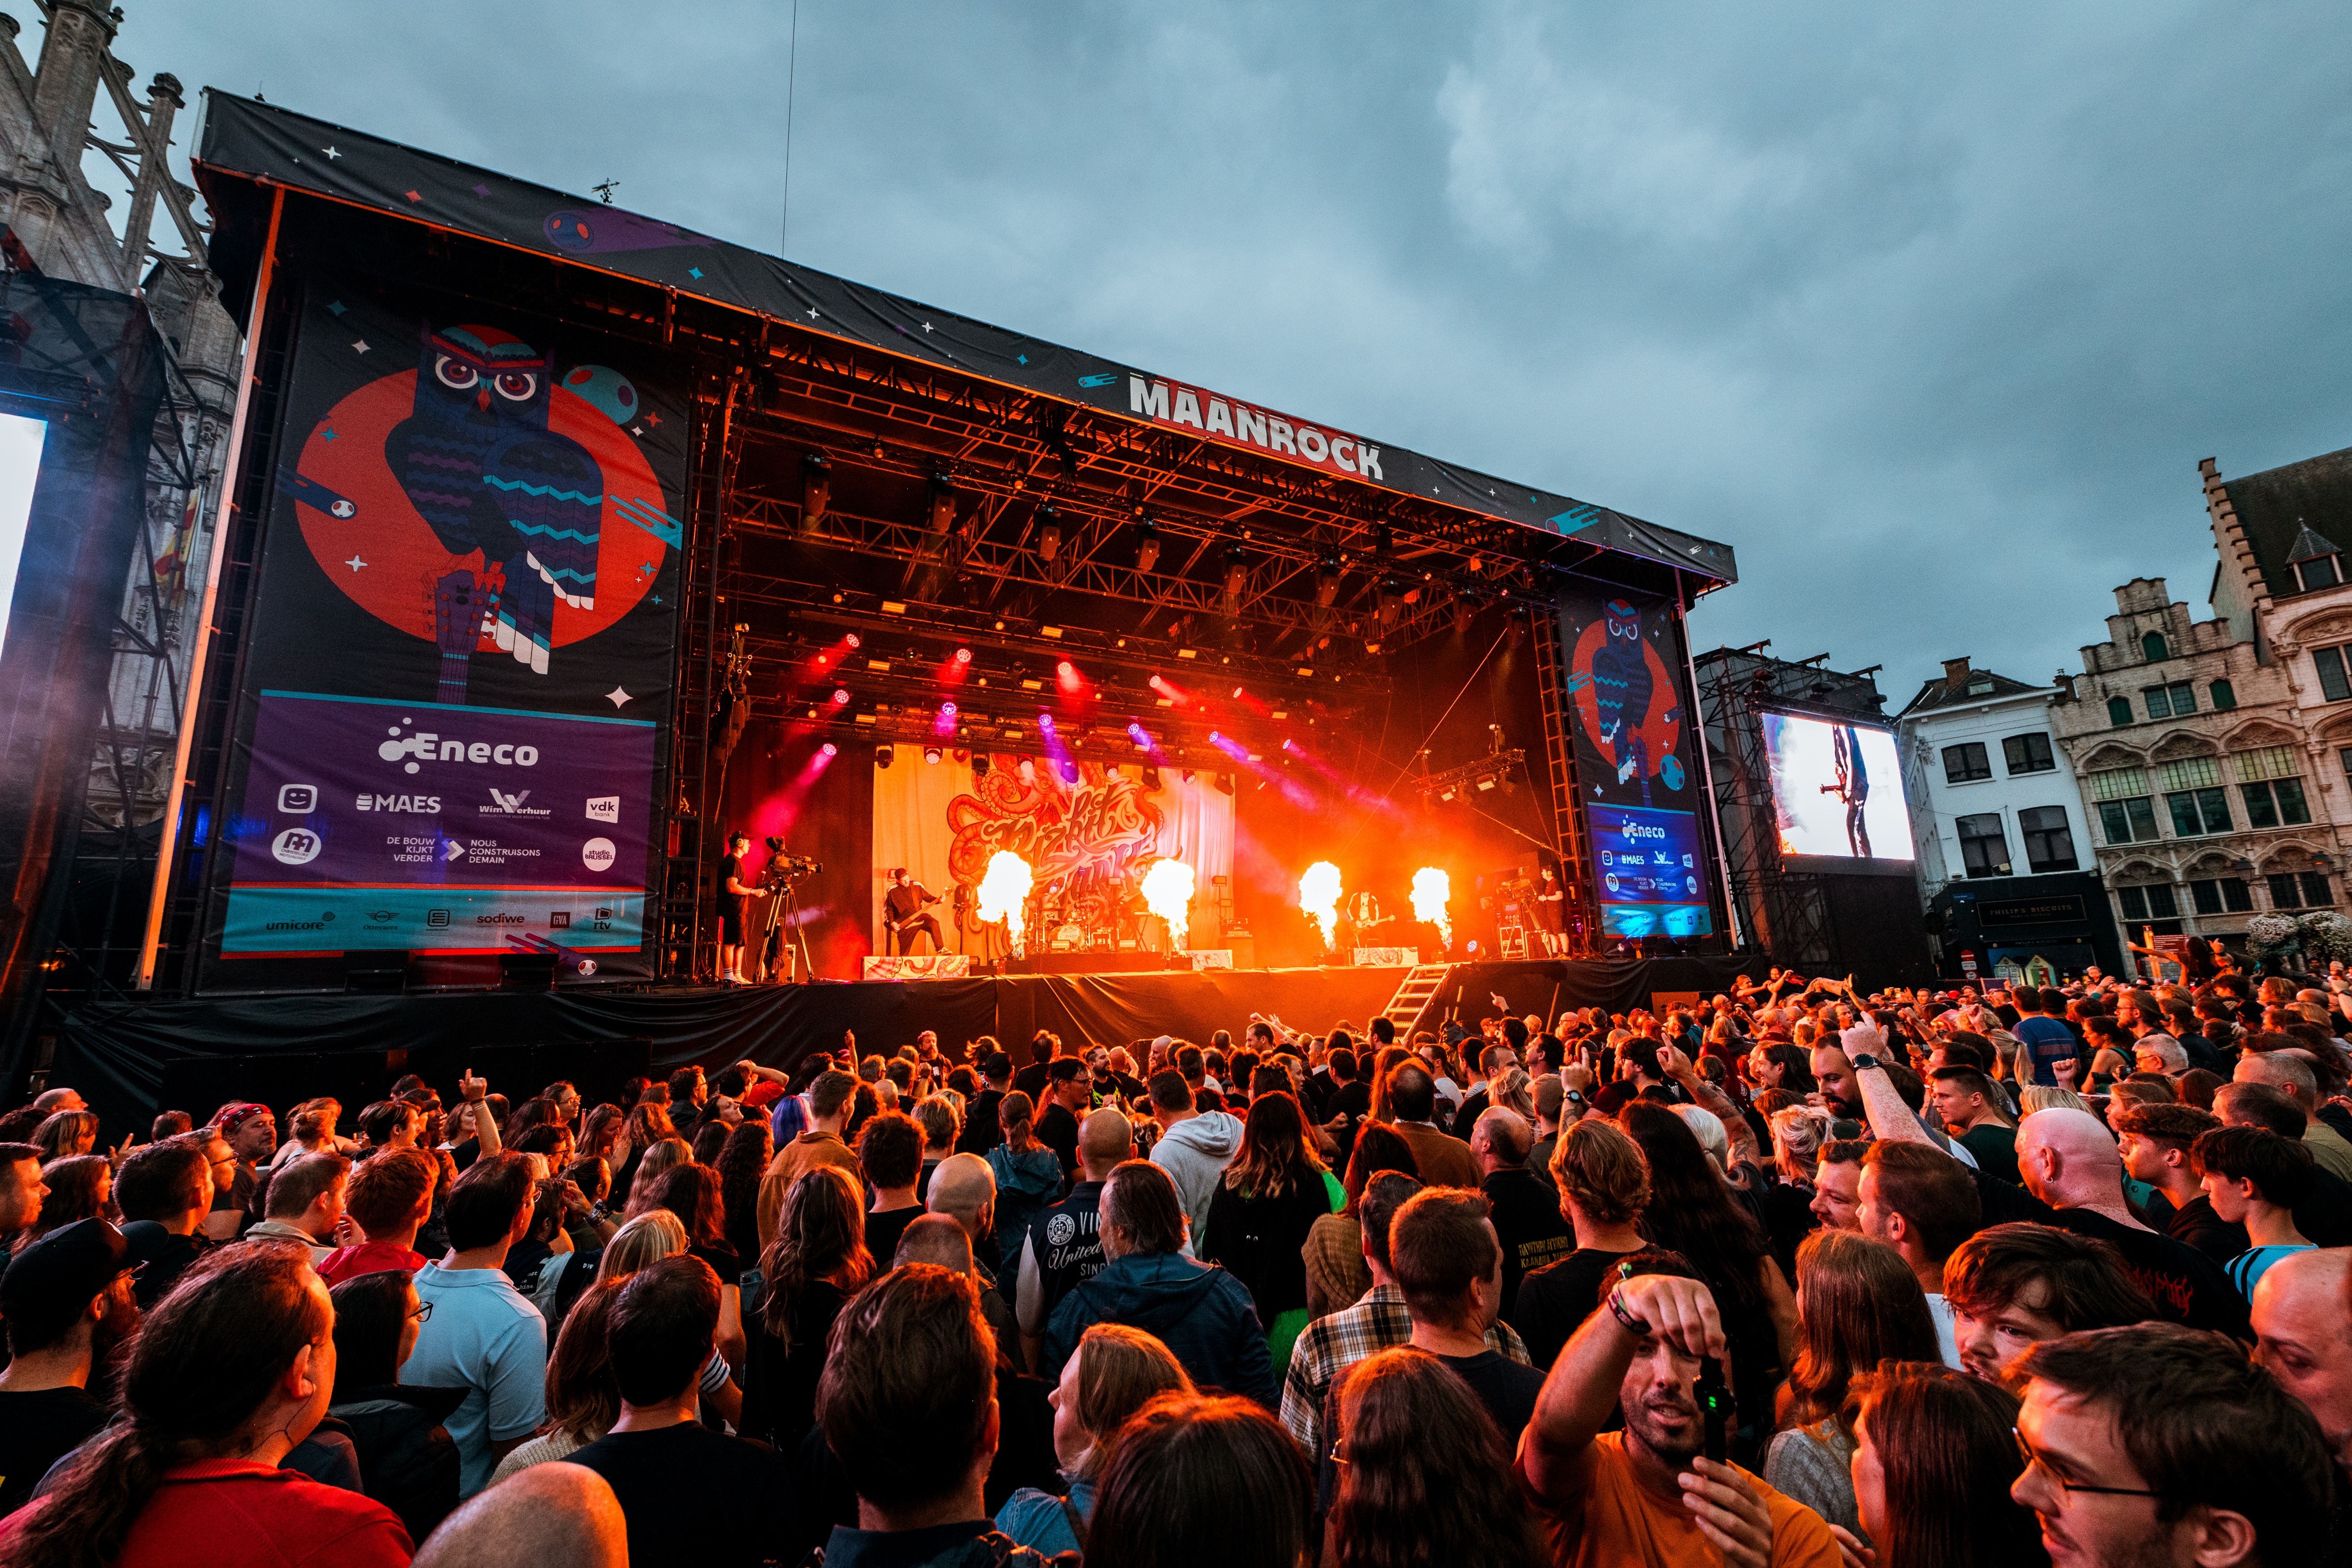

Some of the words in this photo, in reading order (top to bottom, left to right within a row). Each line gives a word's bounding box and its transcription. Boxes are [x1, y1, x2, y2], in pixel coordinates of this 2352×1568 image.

[1130, 372, 1383, 480] MAANROCK
[414, 733, 539, 766] Eneco
[374, 794, 442, 814] MAES
[590, 801, 615, 812] vdk
[1630, 822, 1665, 839] Eneco
[406, 846, 434, 854] KIJKT
[470, 848, 540, 856] CONSTRUISONS
[393, 854, 433, 863] VERDER
[1626, 855, 1645, 865] MAES
[2030, 904, 2072, 913] BISCUITS
[476, 913, 525, 923] sodiwe
[553, 915, 567, 925] GVA
[266, 919, 325, 930] umicore
[594, 921, 612, 930] rtv
[1048, 1239, 1102, 1270] United
